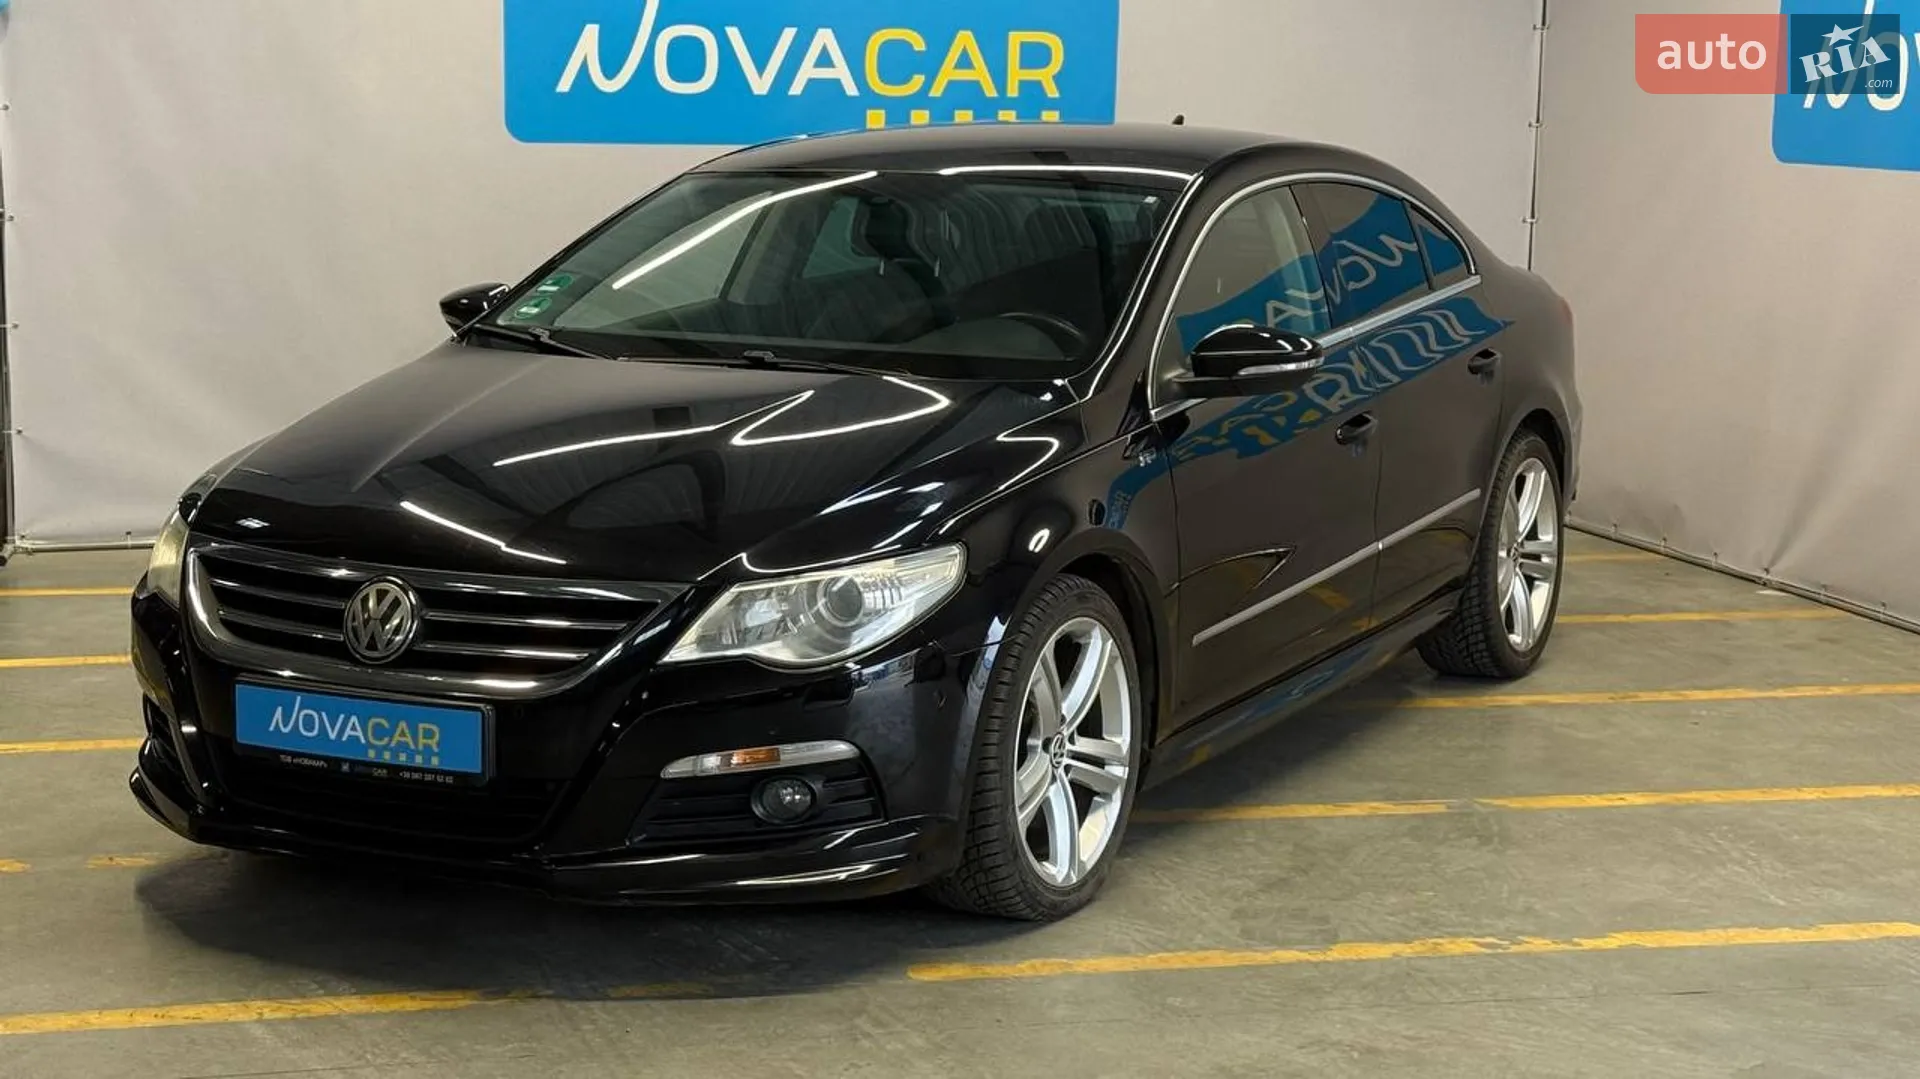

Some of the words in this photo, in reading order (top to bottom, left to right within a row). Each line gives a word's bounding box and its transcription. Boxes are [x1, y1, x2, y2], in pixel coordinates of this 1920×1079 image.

[555, 0, 1065, 98] NOVACAR
[347, 582, 412, 658] VW
[269, 696, 440, 752] NOVACAR
